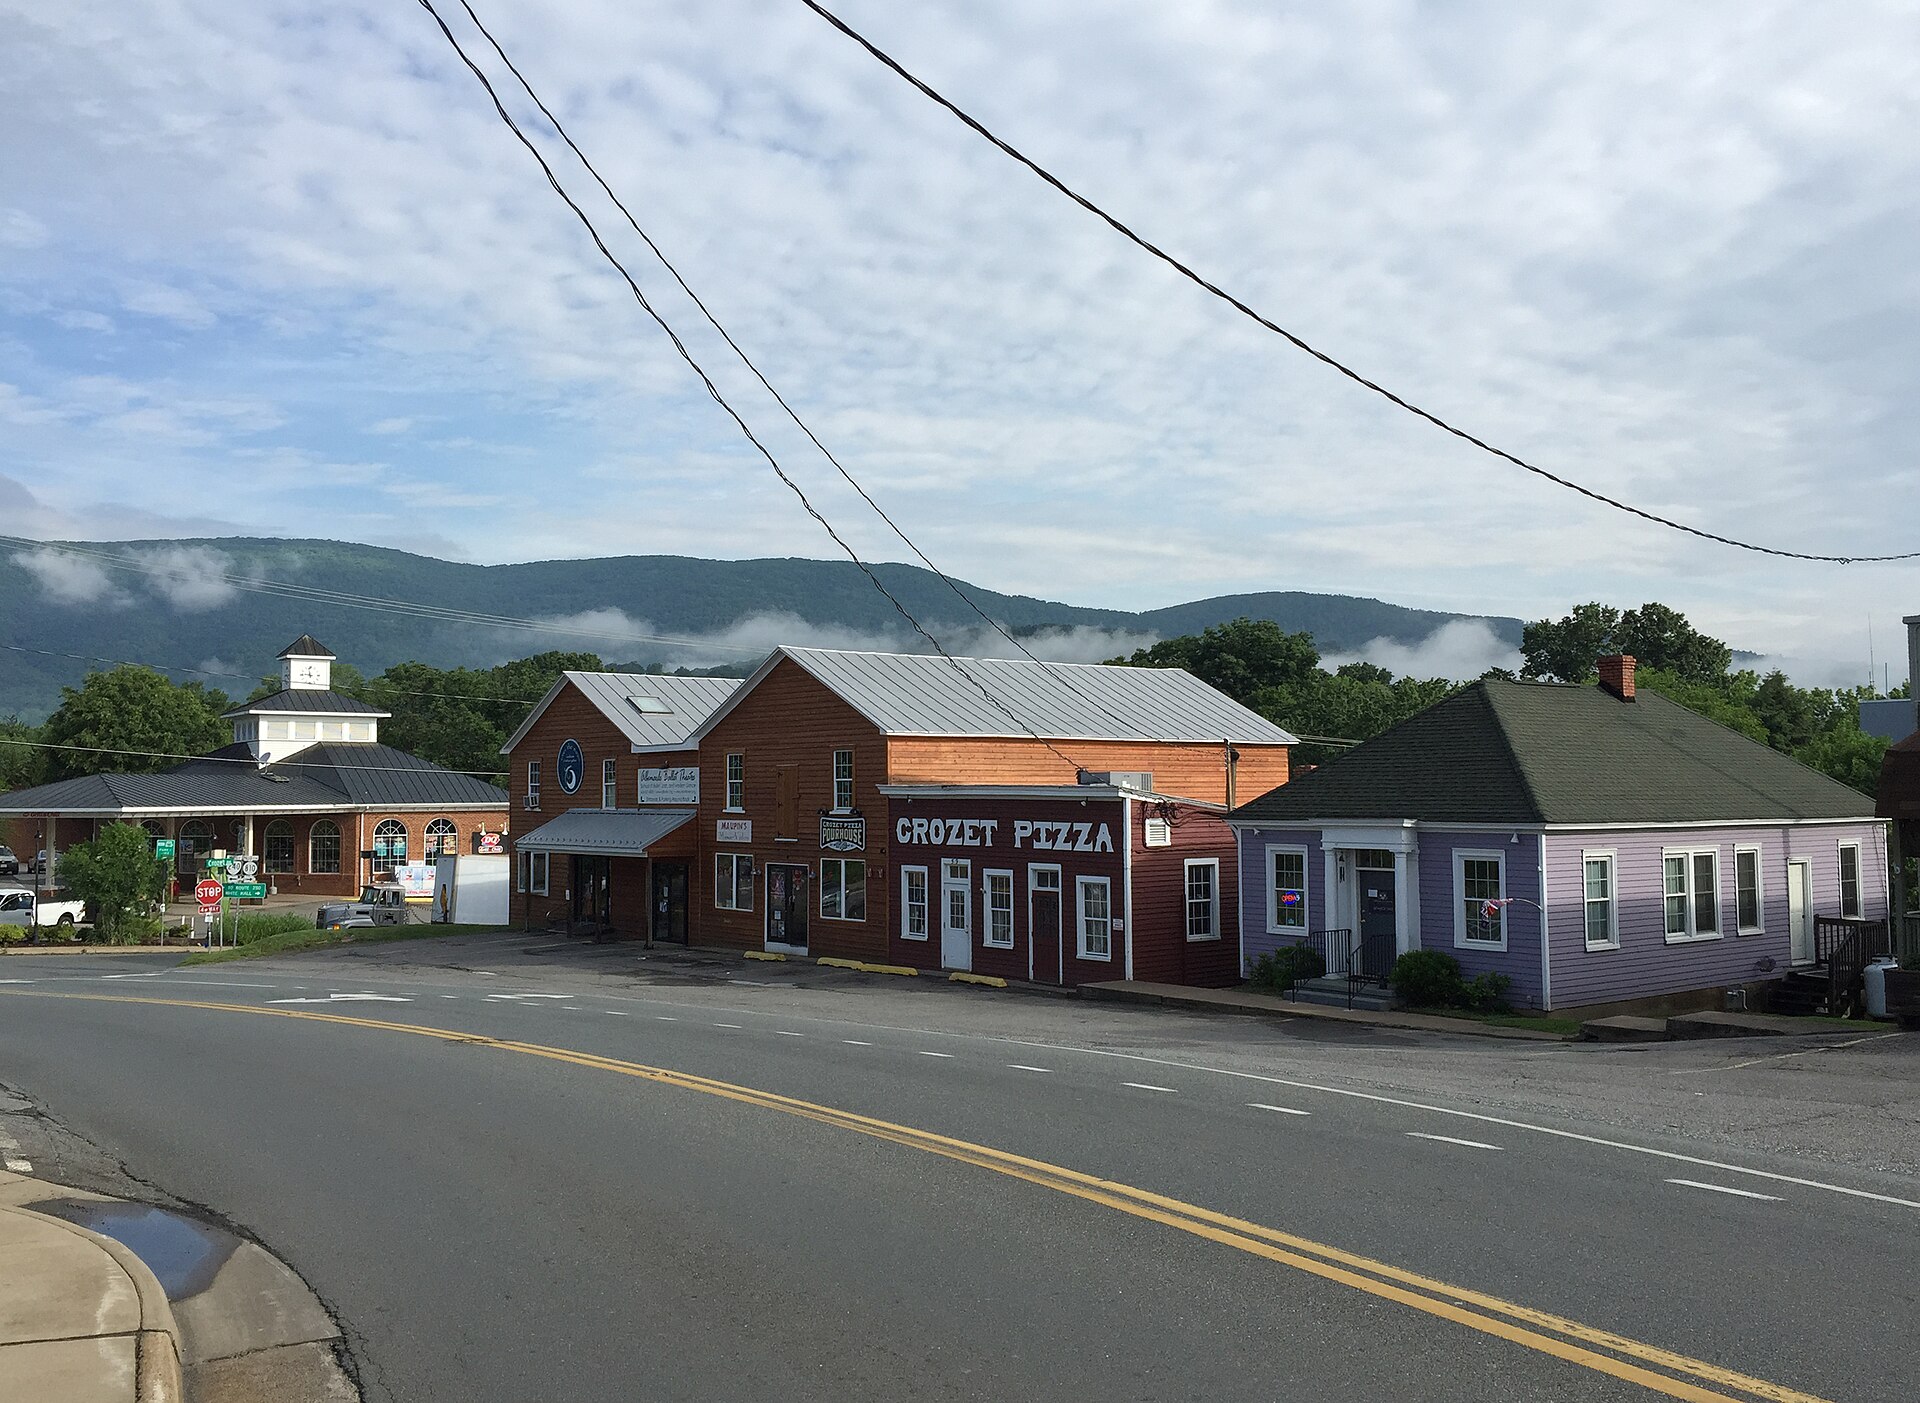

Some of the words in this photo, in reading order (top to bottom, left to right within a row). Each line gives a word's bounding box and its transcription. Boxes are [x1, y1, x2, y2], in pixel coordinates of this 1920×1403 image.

[822, 828, 863, 846] POURHOUSE
[896, 817, 998, 847] CROZET
[1013, 820, 1114, 853] PIZZA
[244, 863, 256, 871] 810
[197, 887, 222, 898] STOP
